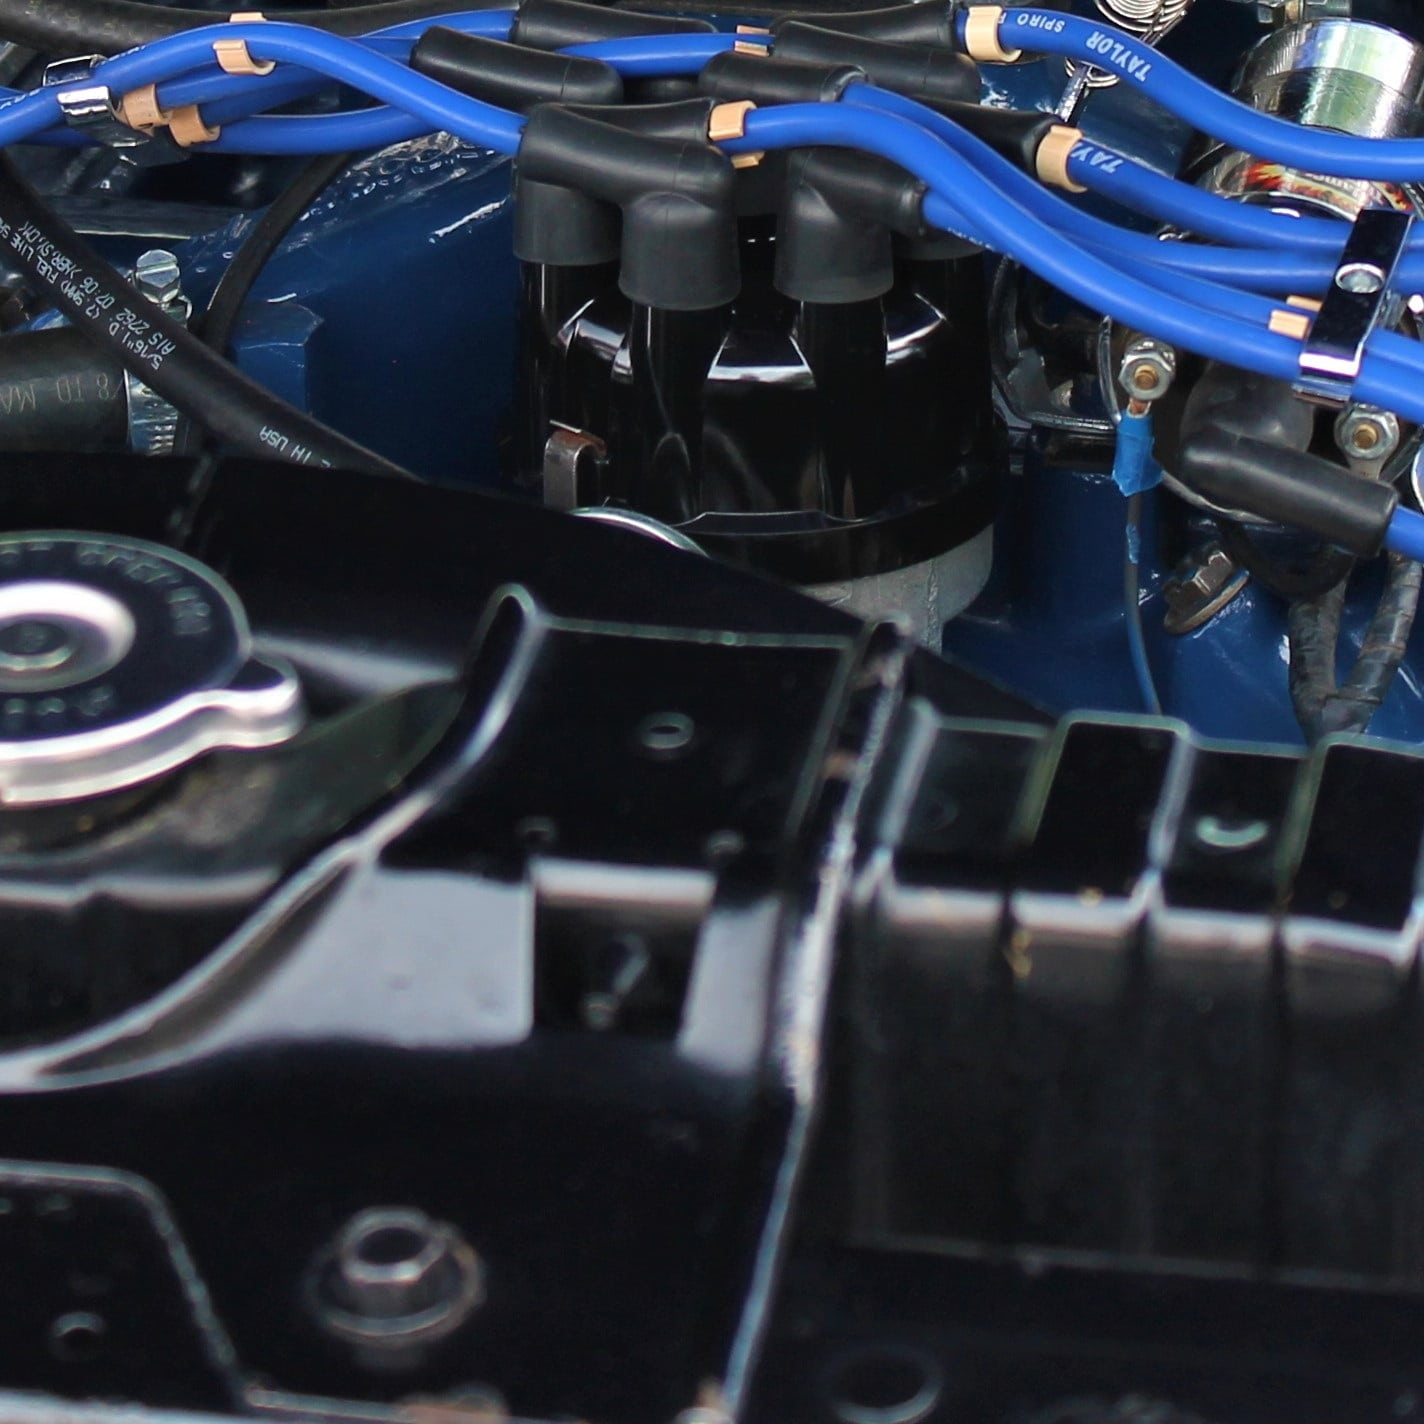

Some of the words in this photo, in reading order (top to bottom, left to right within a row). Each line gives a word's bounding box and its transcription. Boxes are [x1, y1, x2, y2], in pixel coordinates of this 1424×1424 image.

[1016, 12, 1066, 33] SPIRO
[1085, 30, 1153, 82] TAYLOR
[35, 255, 60, 285] FUEL
[115, 307, 151, 335] 2762
[258, 424, 290, 453] USA
